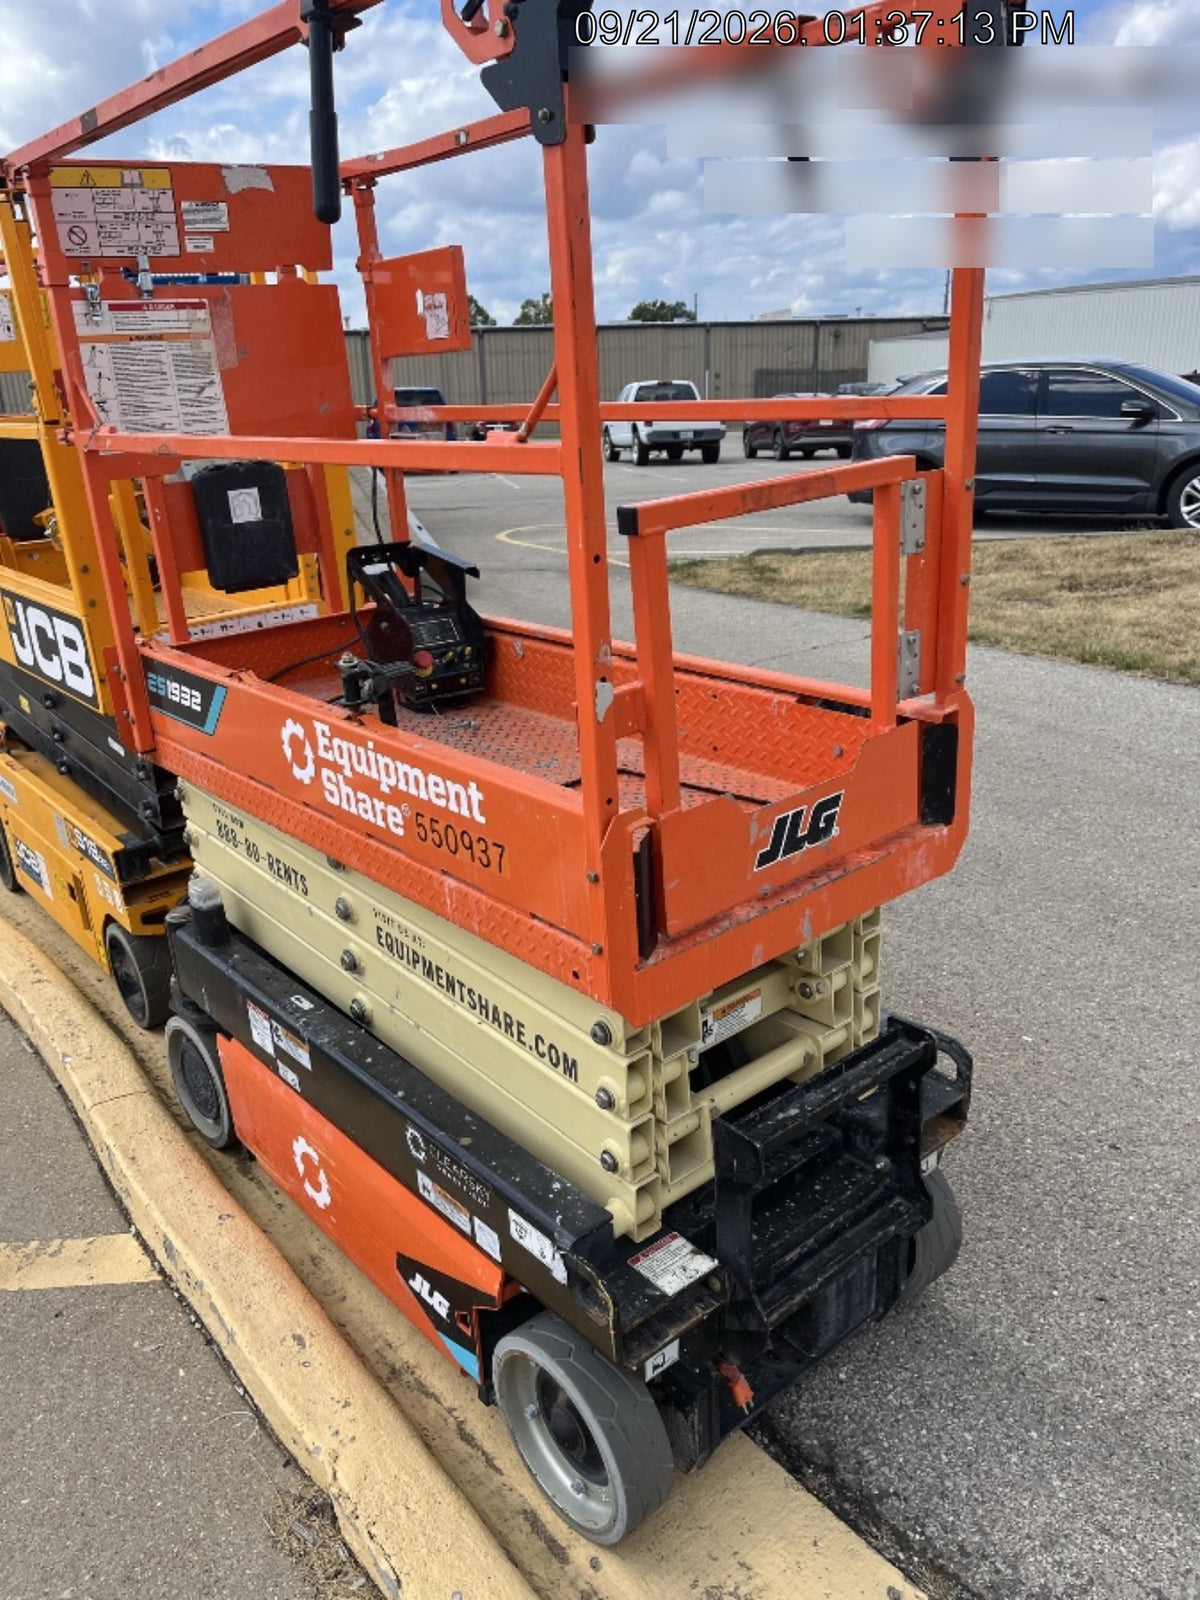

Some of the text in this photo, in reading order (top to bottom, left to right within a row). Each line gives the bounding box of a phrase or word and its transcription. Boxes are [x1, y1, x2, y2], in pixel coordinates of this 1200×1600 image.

[11, 600, 95, 698] JCB
[312, 720, 486, 824] Equipment
[415, 812, 506, 874] 550937
[753, 789, 845, 872] JLG
[375, 925, 580, 1084] EQUIPMENTSHARE.COM
[408, 1271, 451, 1321] JLG
